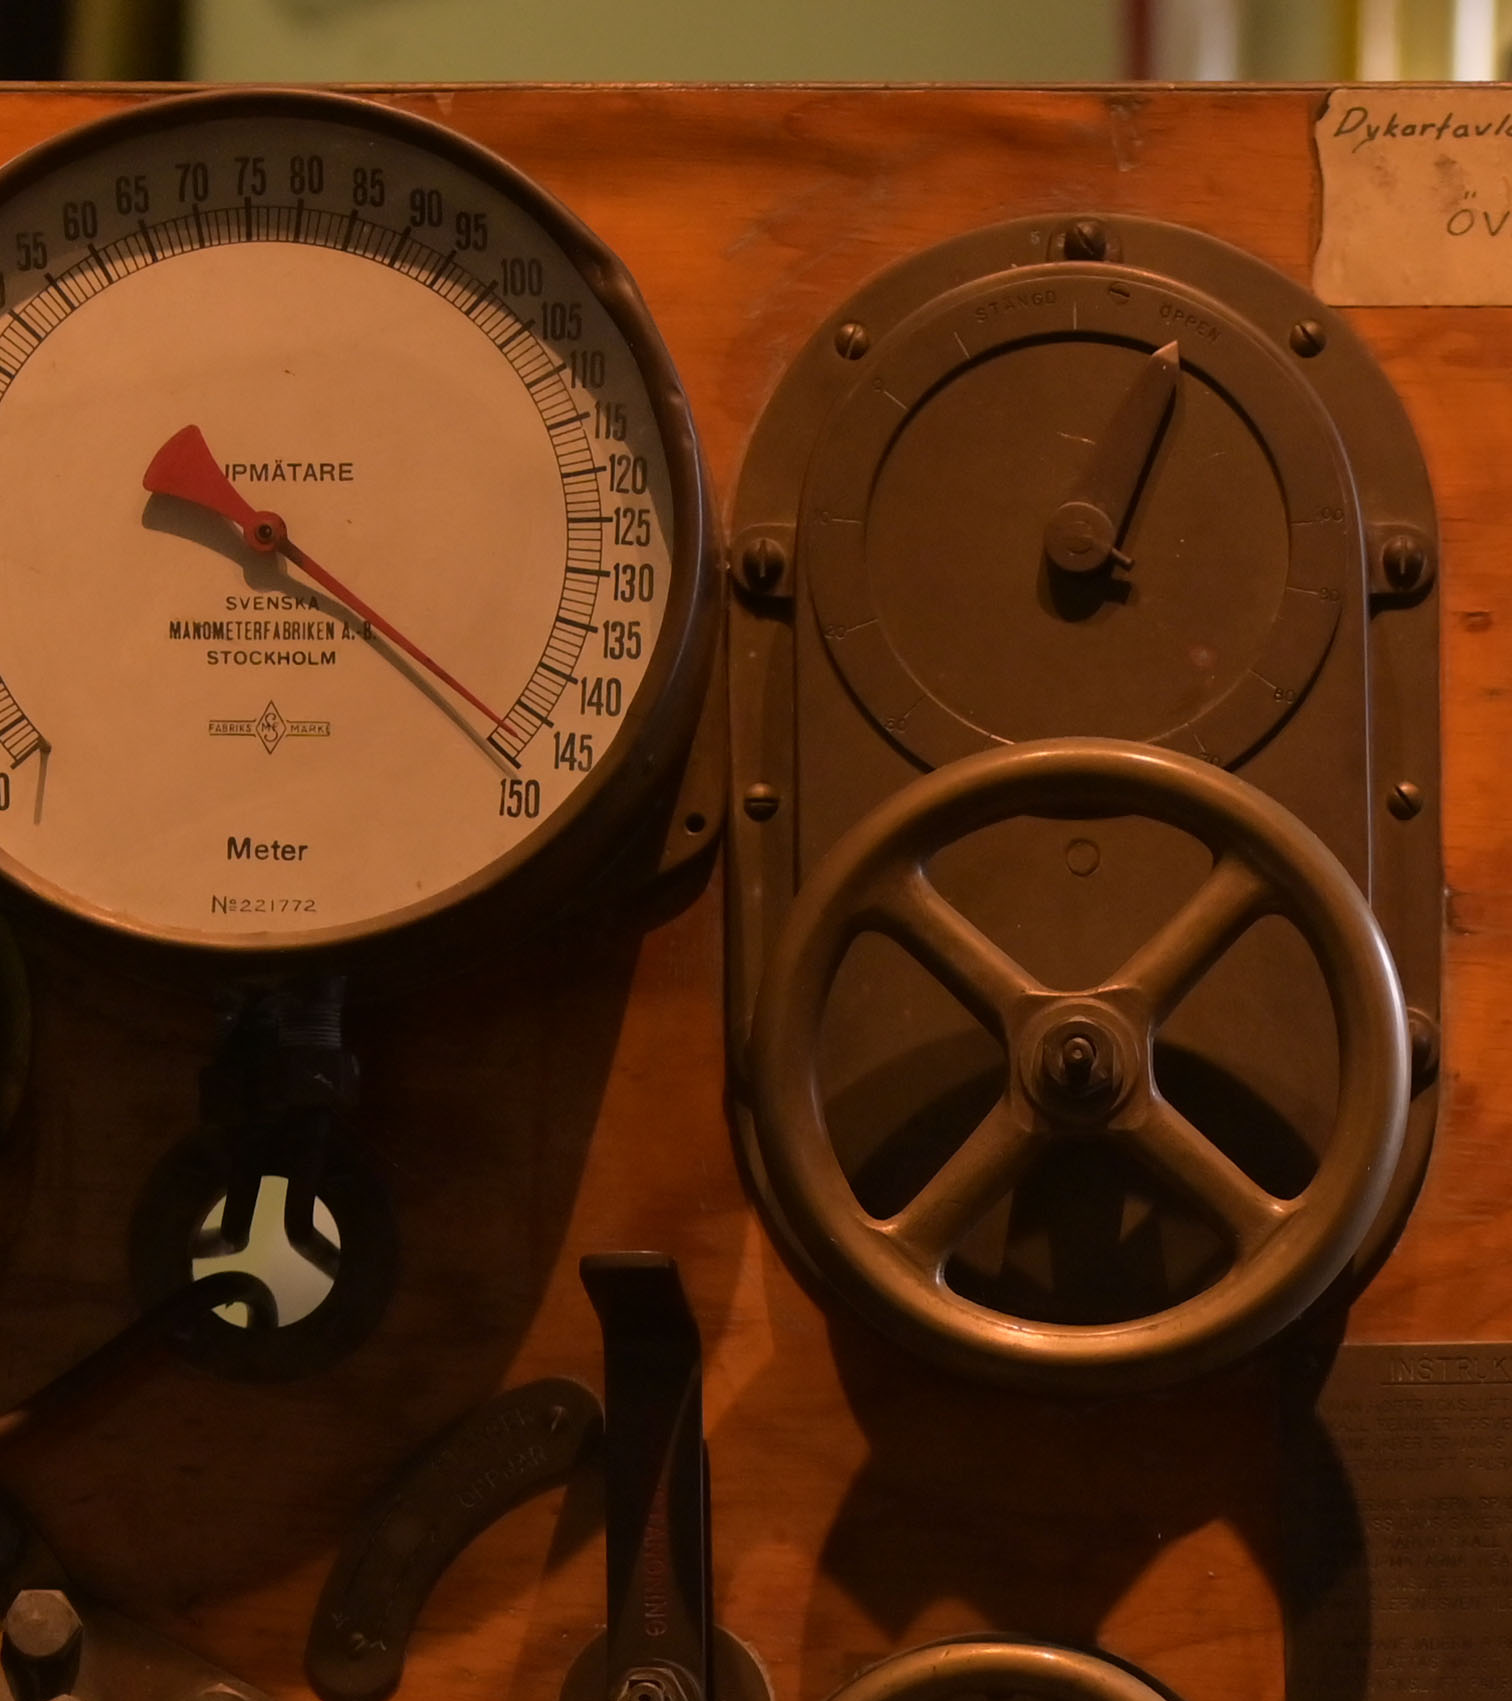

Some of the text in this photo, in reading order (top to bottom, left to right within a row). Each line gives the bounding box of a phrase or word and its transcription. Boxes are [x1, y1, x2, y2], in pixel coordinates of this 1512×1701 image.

[115, 174, 150, 216] 65
[174, 159, 210, 203] 70
[233, 155, 267, 197] 75
[289, 154, 324, 196] 80
[352, 166, 385, 209] 85
[62, 199, 98, 242] 60
[409, 187, 444, 228] 90
[613, 506, 651, 548] 125
[226, 596, 320, 612] SVENSKA
[169, 620, 336, 642] MANOMETERFABRIKEN
[206, 650, 336, 666] STOCKHOLM
[498, 777, 541, 819] 150
[227, 836, 309, 862] Meter
